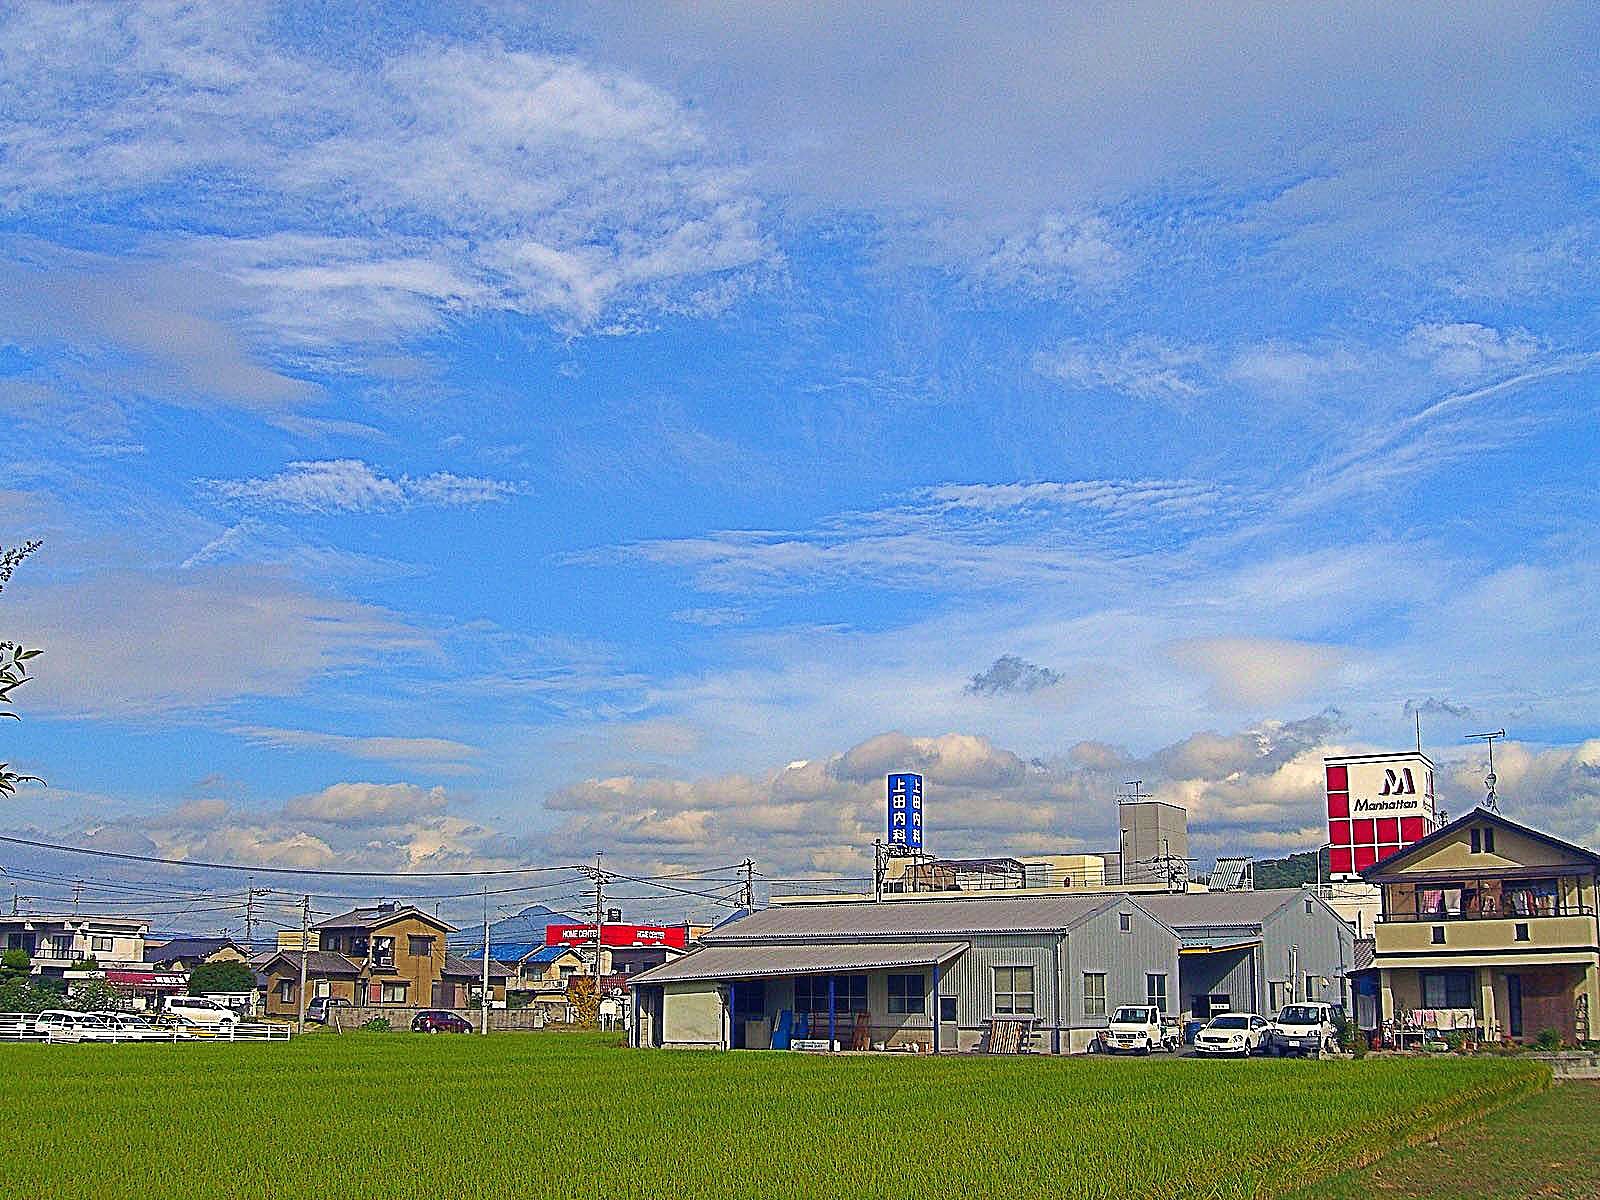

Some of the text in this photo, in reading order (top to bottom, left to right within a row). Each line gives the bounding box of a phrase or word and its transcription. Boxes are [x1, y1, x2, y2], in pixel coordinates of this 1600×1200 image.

[893, 778, 906, 843] 上田内科
[912, 779, 921, 844] 上田内科
[1353, 798, 1418, 812] Manhattan
[562, 929, 600, 938] HOME CENTE
